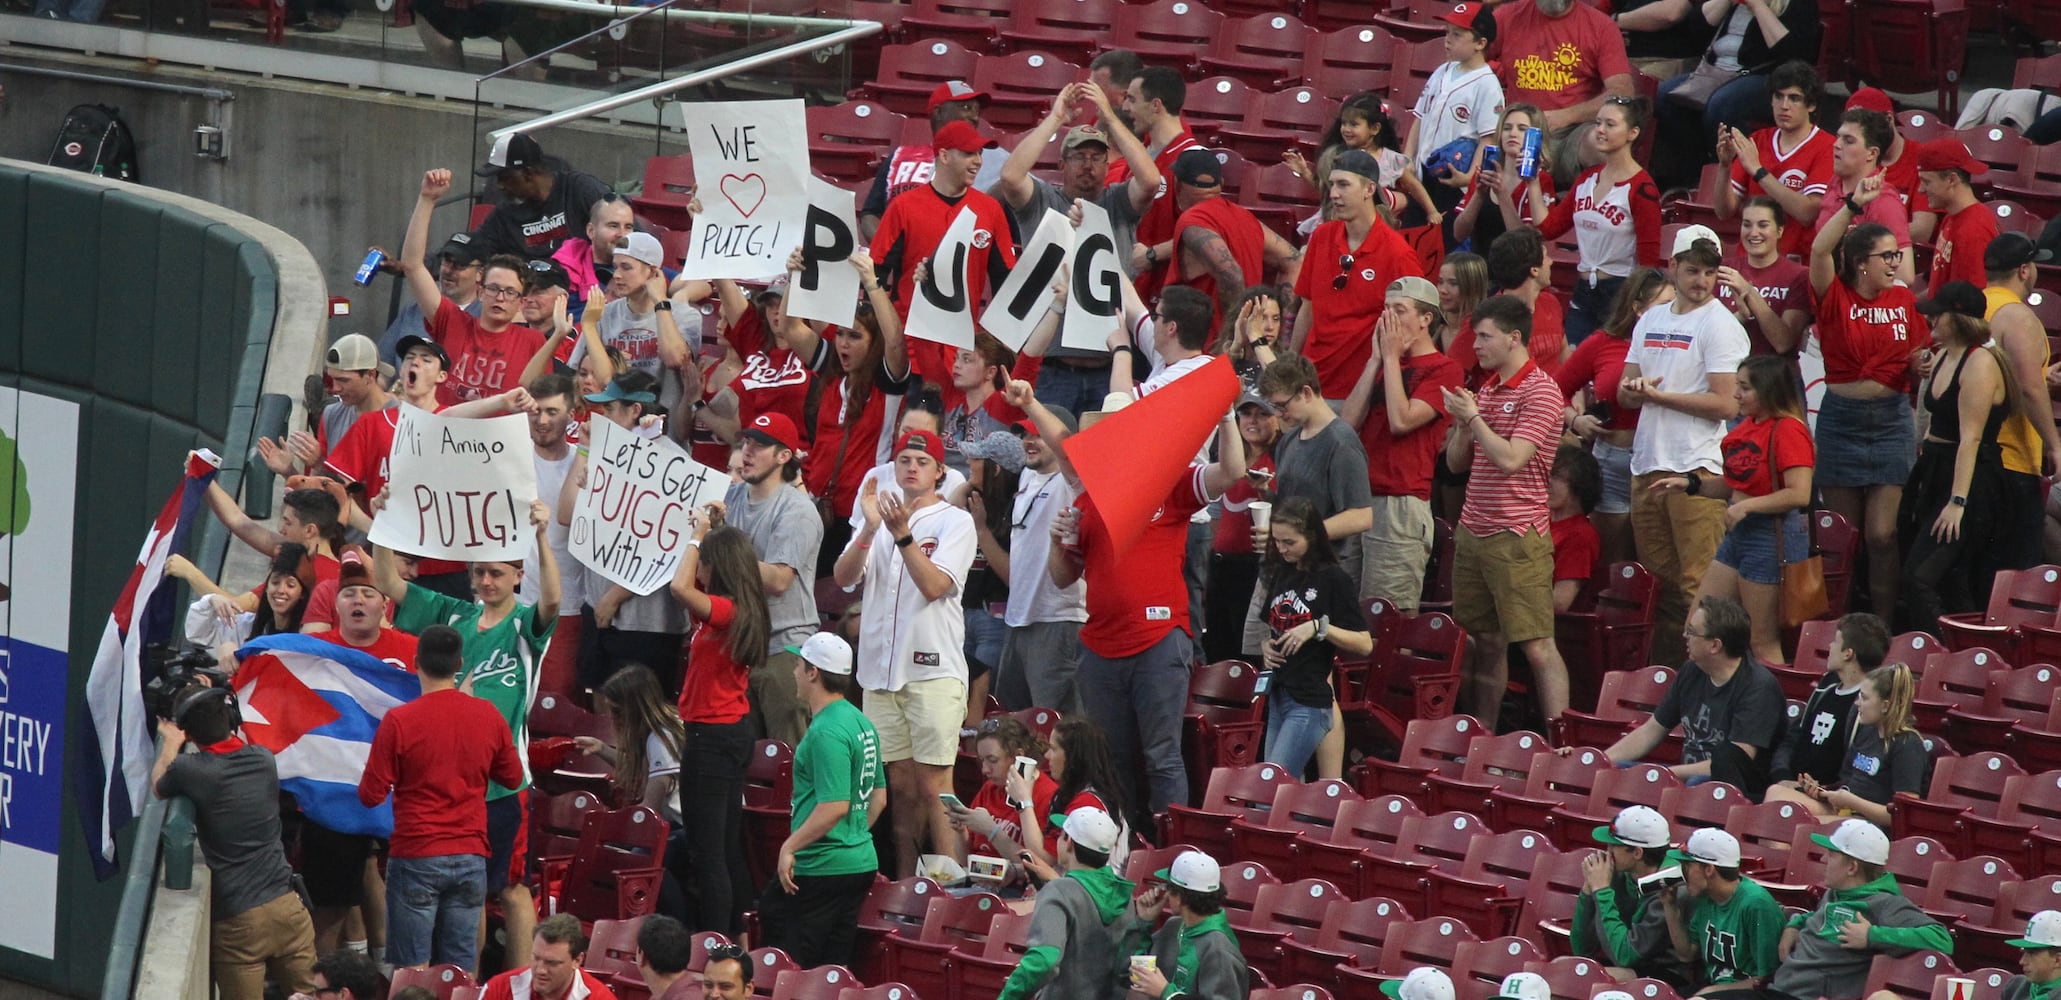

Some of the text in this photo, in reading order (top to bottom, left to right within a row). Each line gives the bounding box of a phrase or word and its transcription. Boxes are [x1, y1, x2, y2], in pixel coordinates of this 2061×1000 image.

[1514, 58, 1556, 71] ALWAYS
[1518, 68, 1573, 84] SONNY
[710, 123, 760, 162] WE
[893, 161, 936, 186] RE
[700, 220, 781, 260] PUIG!
[1720, 285, 1789, 300] WCAT
[1892, 324, 1906, 340] 19
[452, 352, 506, 390] ASG
[740, 350, 806, 392] Reds
[440, 426, 504, 464] Amigo
[602, 422, 708, 508] Let's Get
[414, 484, 518, 548] PUIG!
[588, 464, 697, 552] PUIGG
[592, 518, 676, 592] With it!
[1506, 978, 1523, 994] H
